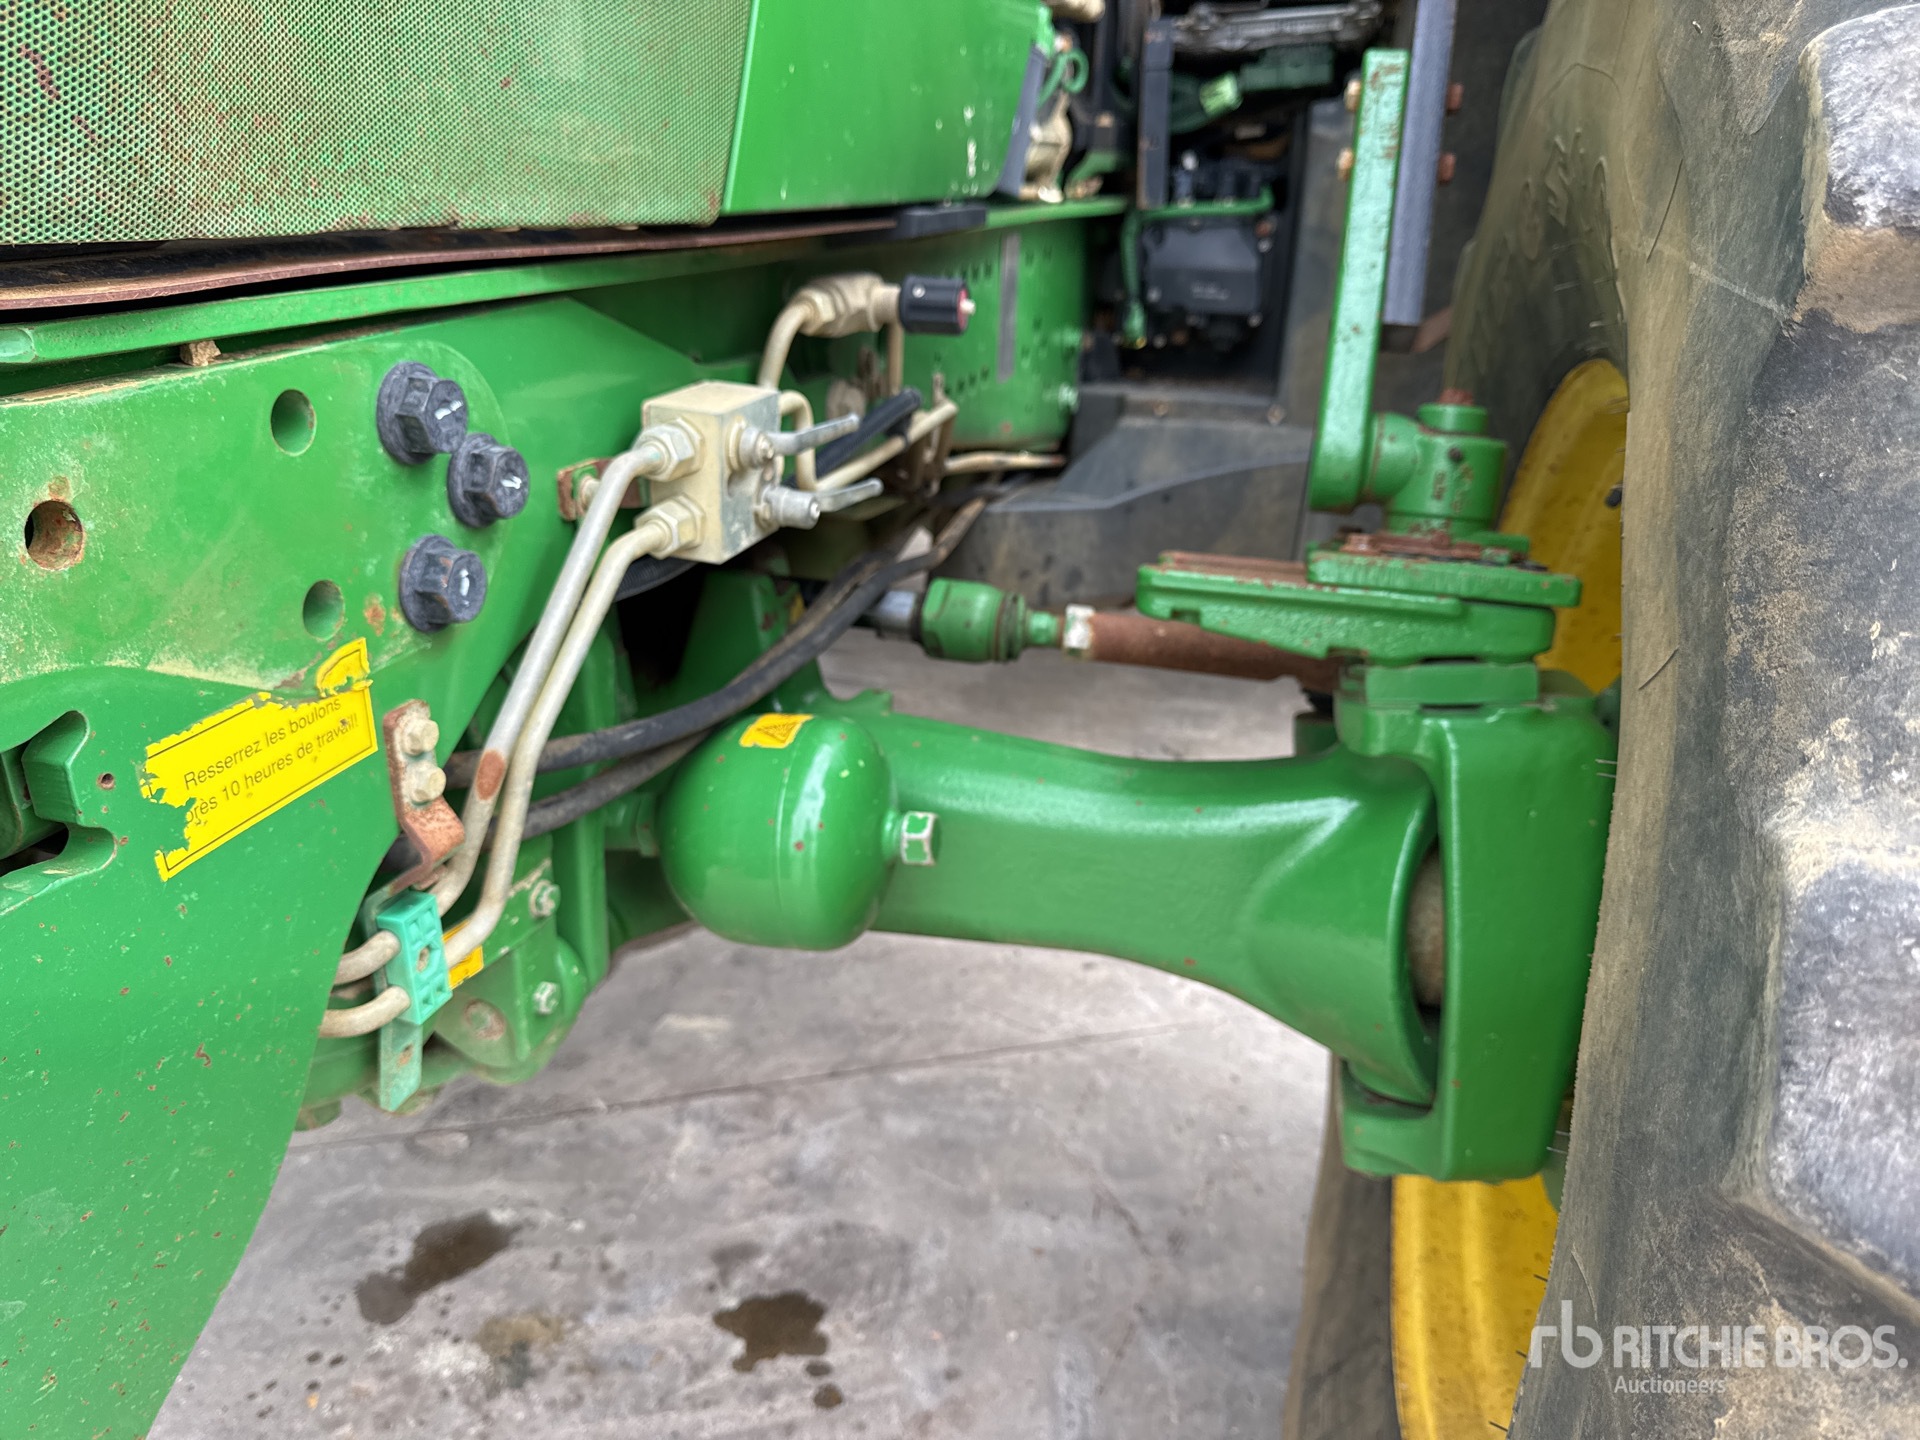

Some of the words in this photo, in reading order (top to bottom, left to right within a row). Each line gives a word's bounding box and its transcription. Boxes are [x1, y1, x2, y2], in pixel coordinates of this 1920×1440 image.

[183, 740, 263, 790] Resserrez
[264, 726, 287, 748] les
[288, 698, 342, 734] boulons
[221, 780, 241, 801] 10
[243, 753, 294, 789] heures
[296, 741, 314, 760] de
[315, 712, 359, 748] travail!
